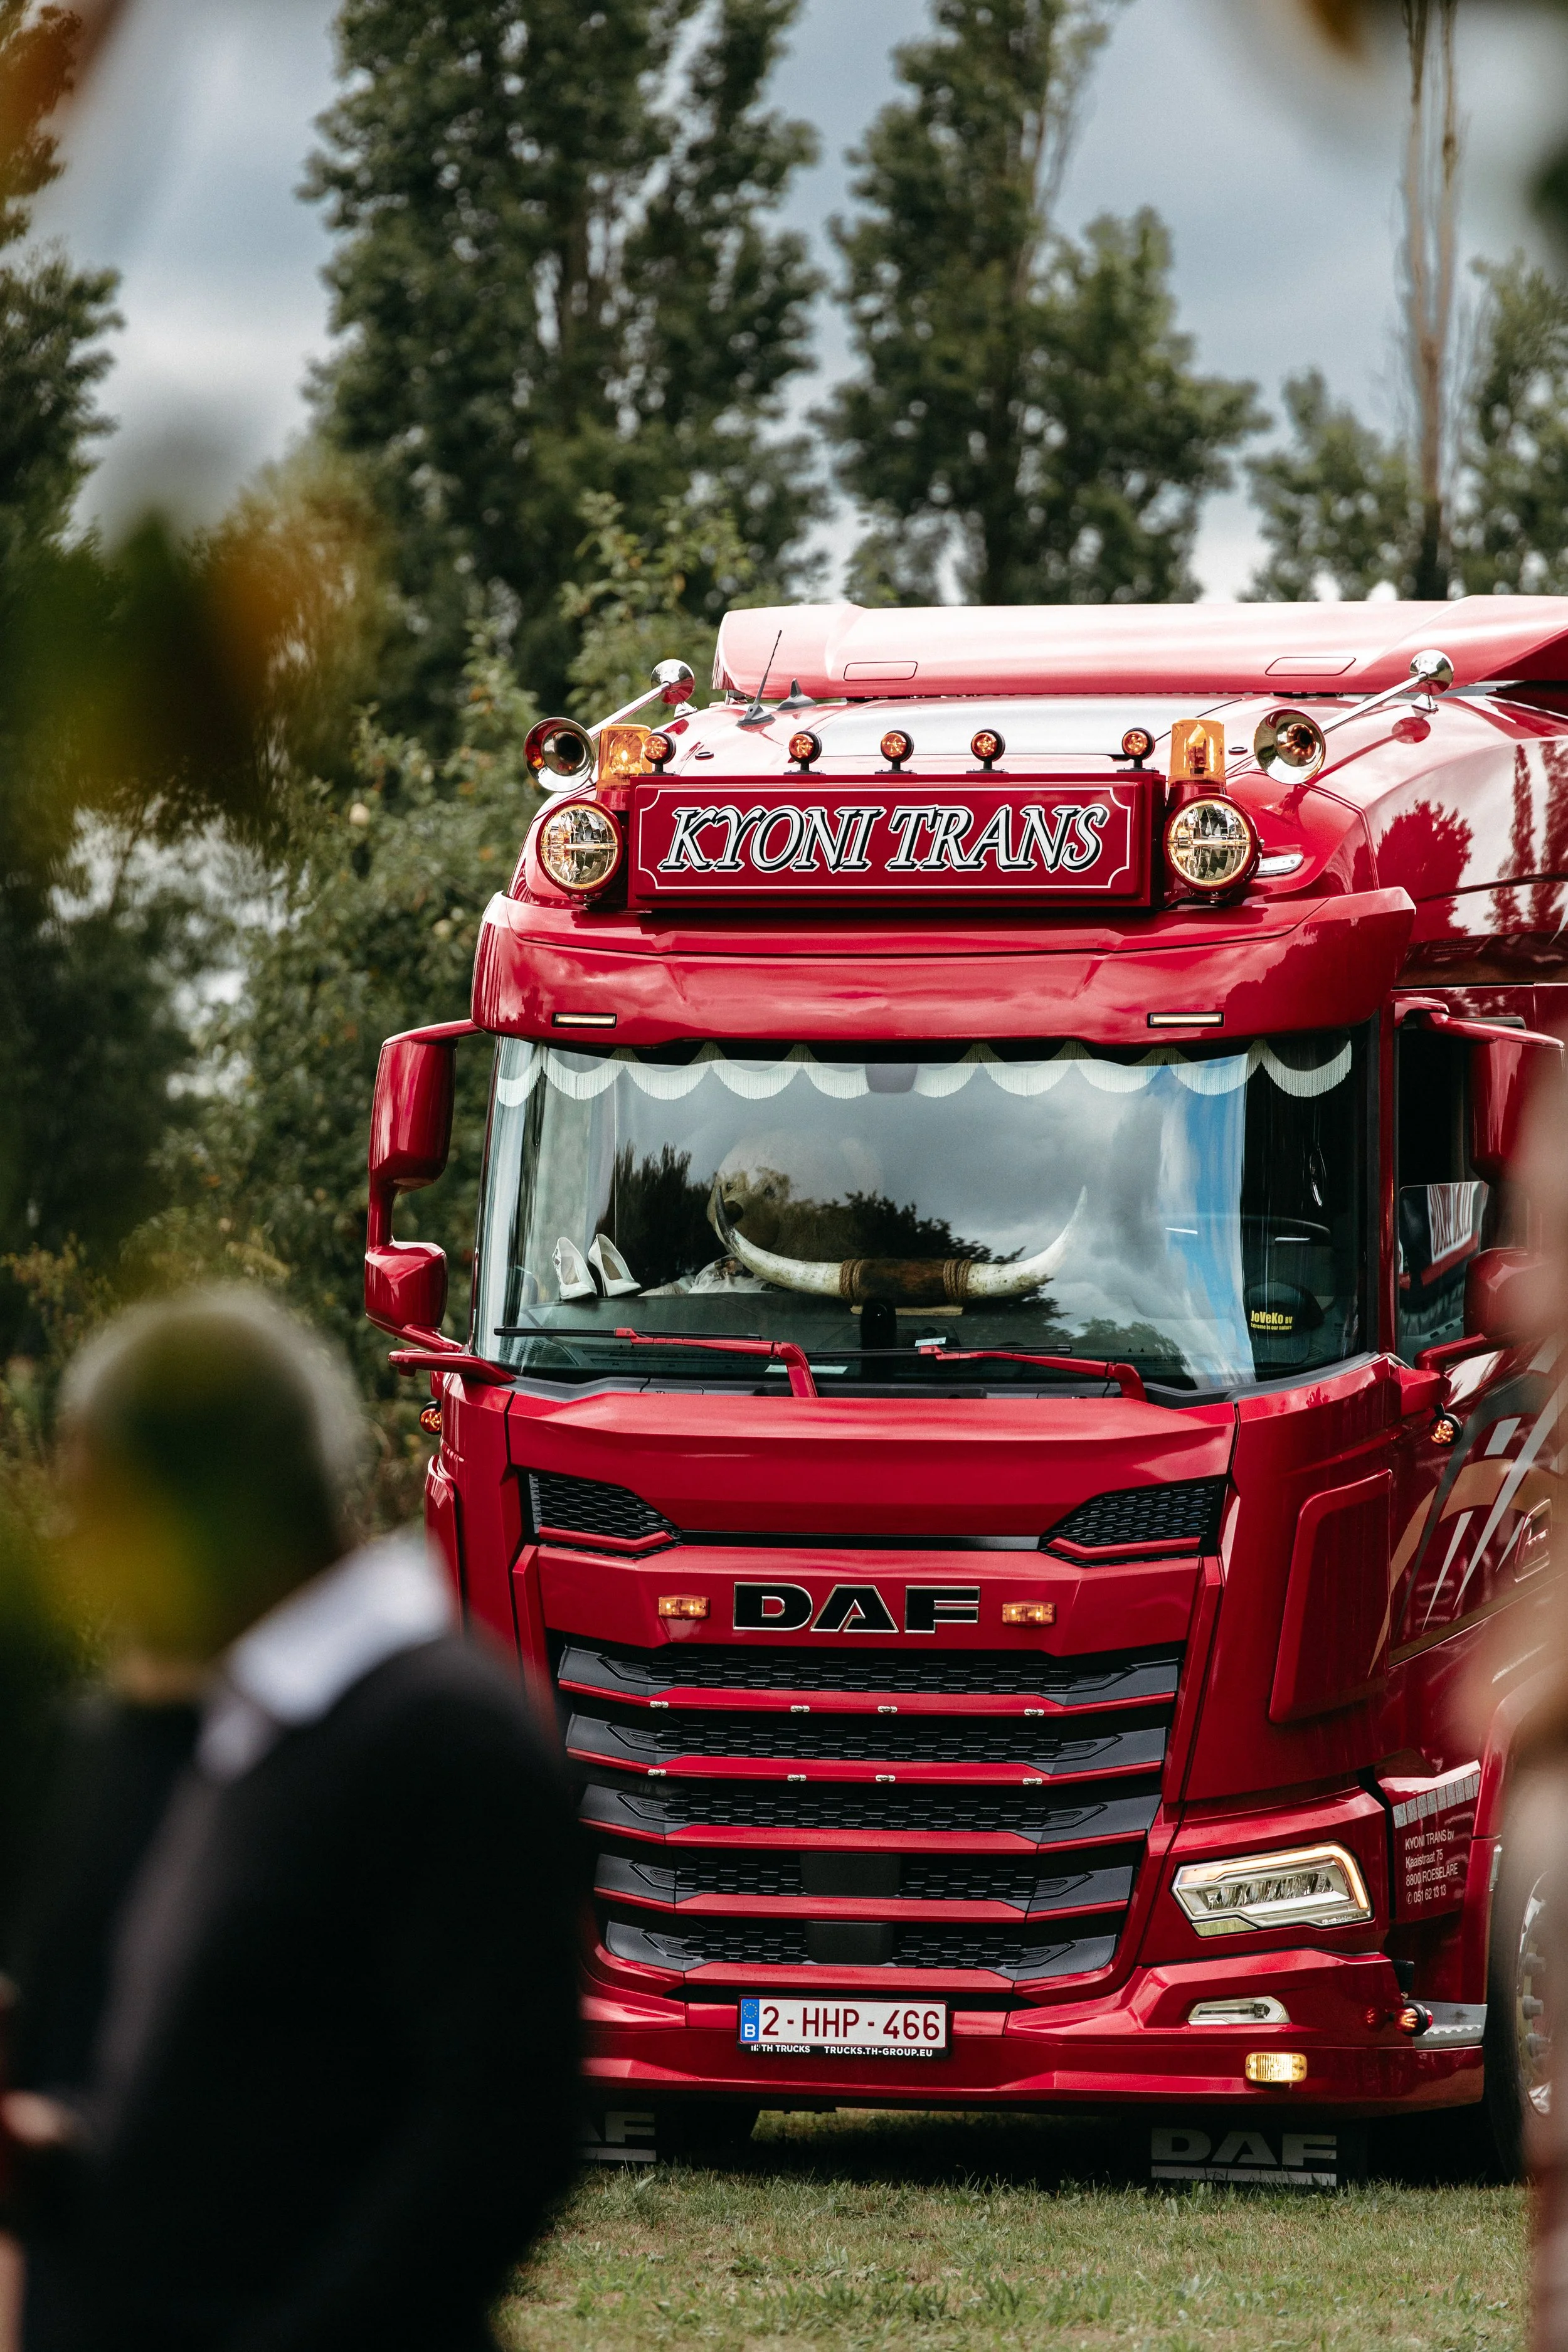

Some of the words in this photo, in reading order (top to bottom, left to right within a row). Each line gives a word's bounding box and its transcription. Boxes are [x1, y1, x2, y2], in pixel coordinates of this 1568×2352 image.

[657, 805, 886, 874] KYONI
[886, 804, 1110, 874] TRANS
[1251, 1310, 1283, 1324] JoVeKo
[1285, 1316, 1293, 1324] BV
[733, 1581, 980, 1634] DAF
[1405, 1835, 1425, 1850] KYONI
[1426, 1830, 1446, 1845] TRANS
[1447, 1828, 1454, 1841] bv
[1406, 1852, 1435, 1868] Kaaistraat
[1436, 1848, 1443, 1861] 75
[1406, 1872, 1421, 1887] 8800
[1422, 1863, 1458, 1882] ROESELARE
[1414, 1889, 1424, 1903] 051
[1424, 1887, 1432, 1900] 62
[1433, 1885, 1439, 1898] 13
[1440, 1883, 1446, 1897] 13
[744, 2023, 756, 2038] B
[761, 2044, 773, 2052] TH
[775, 2045, 810, 2053] TRUCKS
[824, 2046, 933, 2057] TRUCKS.TH-GROUP.EU
[1150, 2127, 1337, 2166] DAF
